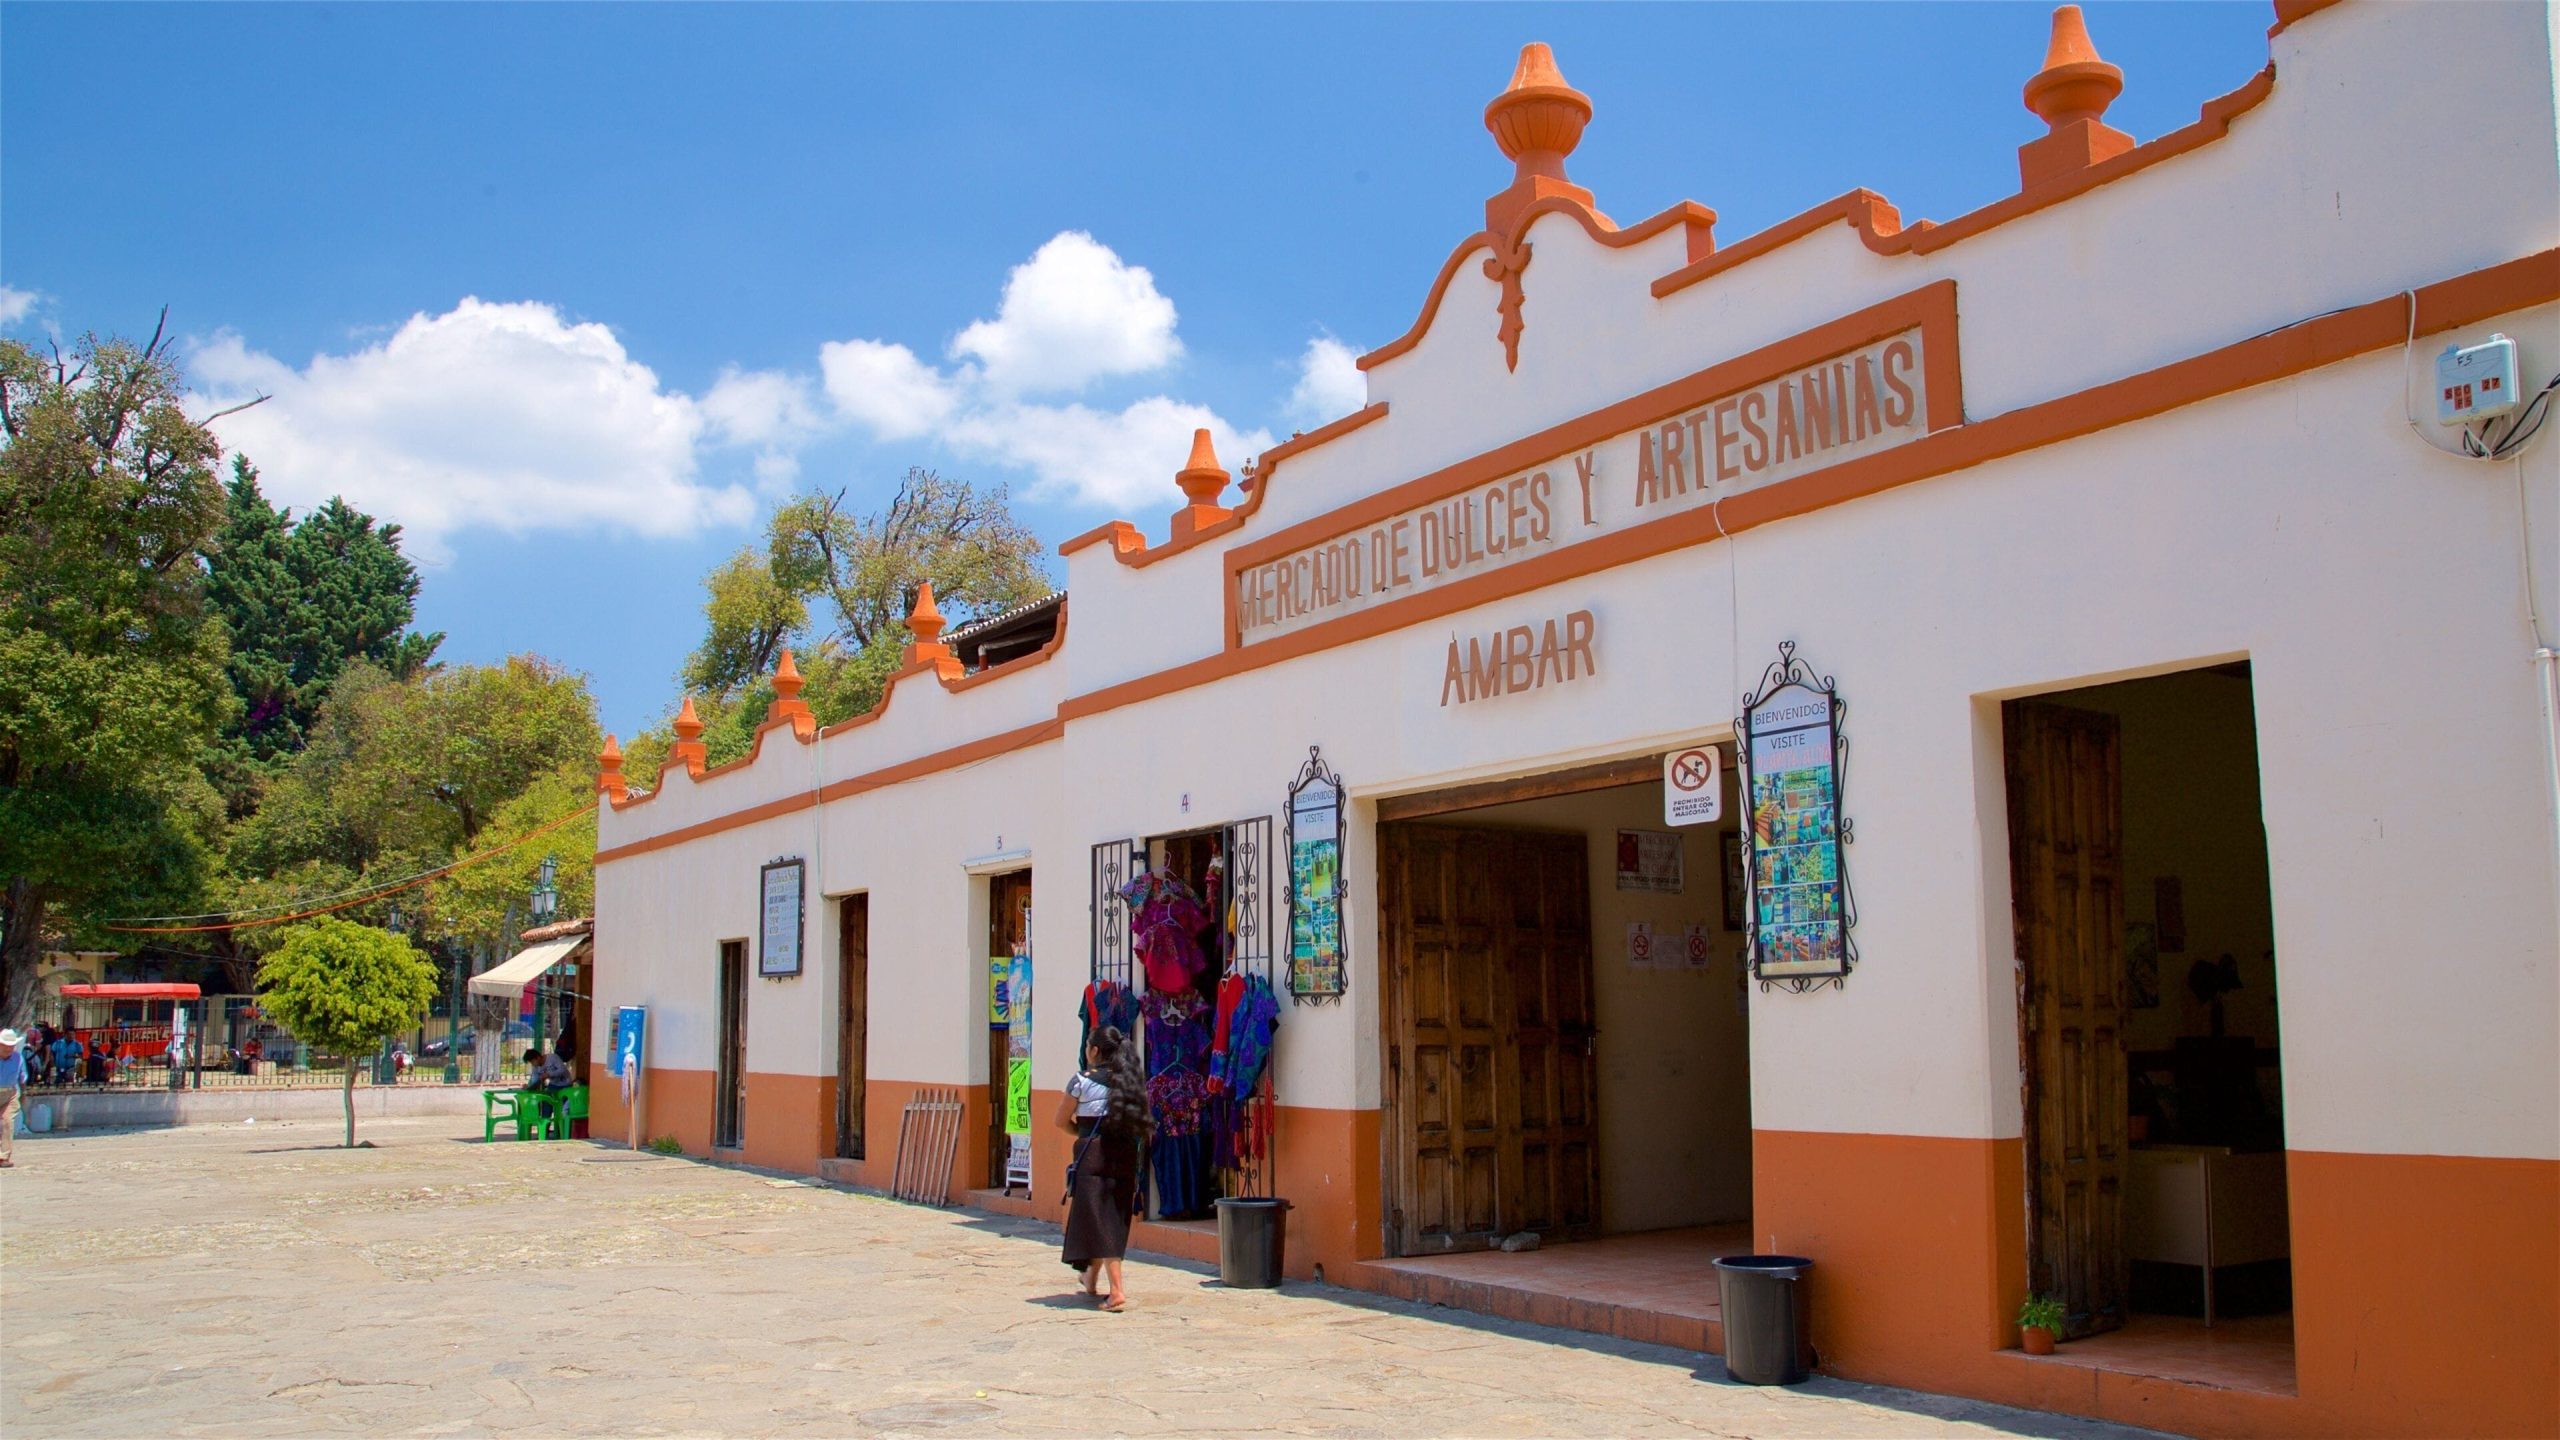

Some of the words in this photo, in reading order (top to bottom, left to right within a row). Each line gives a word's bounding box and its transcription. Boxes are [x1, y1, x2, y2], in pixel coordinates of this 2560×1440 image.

[1235, 537, 1361, 632] MERCADO
[1371, 519, 1411, 593] DE
[1419, 471, 1551, 578] DULCES
[1573, 451, 1595, 526] Y
[1635, 341, 1915, 507] ARTESANIAS
[1440, 610, 1596, 706] AMBAR
[1755, 702, 1826, 725] BIENVENIDOS
[1770, 734, 1806, 750] VISITE
[1181, 794, 1189, 811] 4
[1296, 791, 1335, 804] BIENVENIDOS
[1673, 796, 1711, 806] PROHIBIDO
[1305, 812, 1324, 824] VISITE
